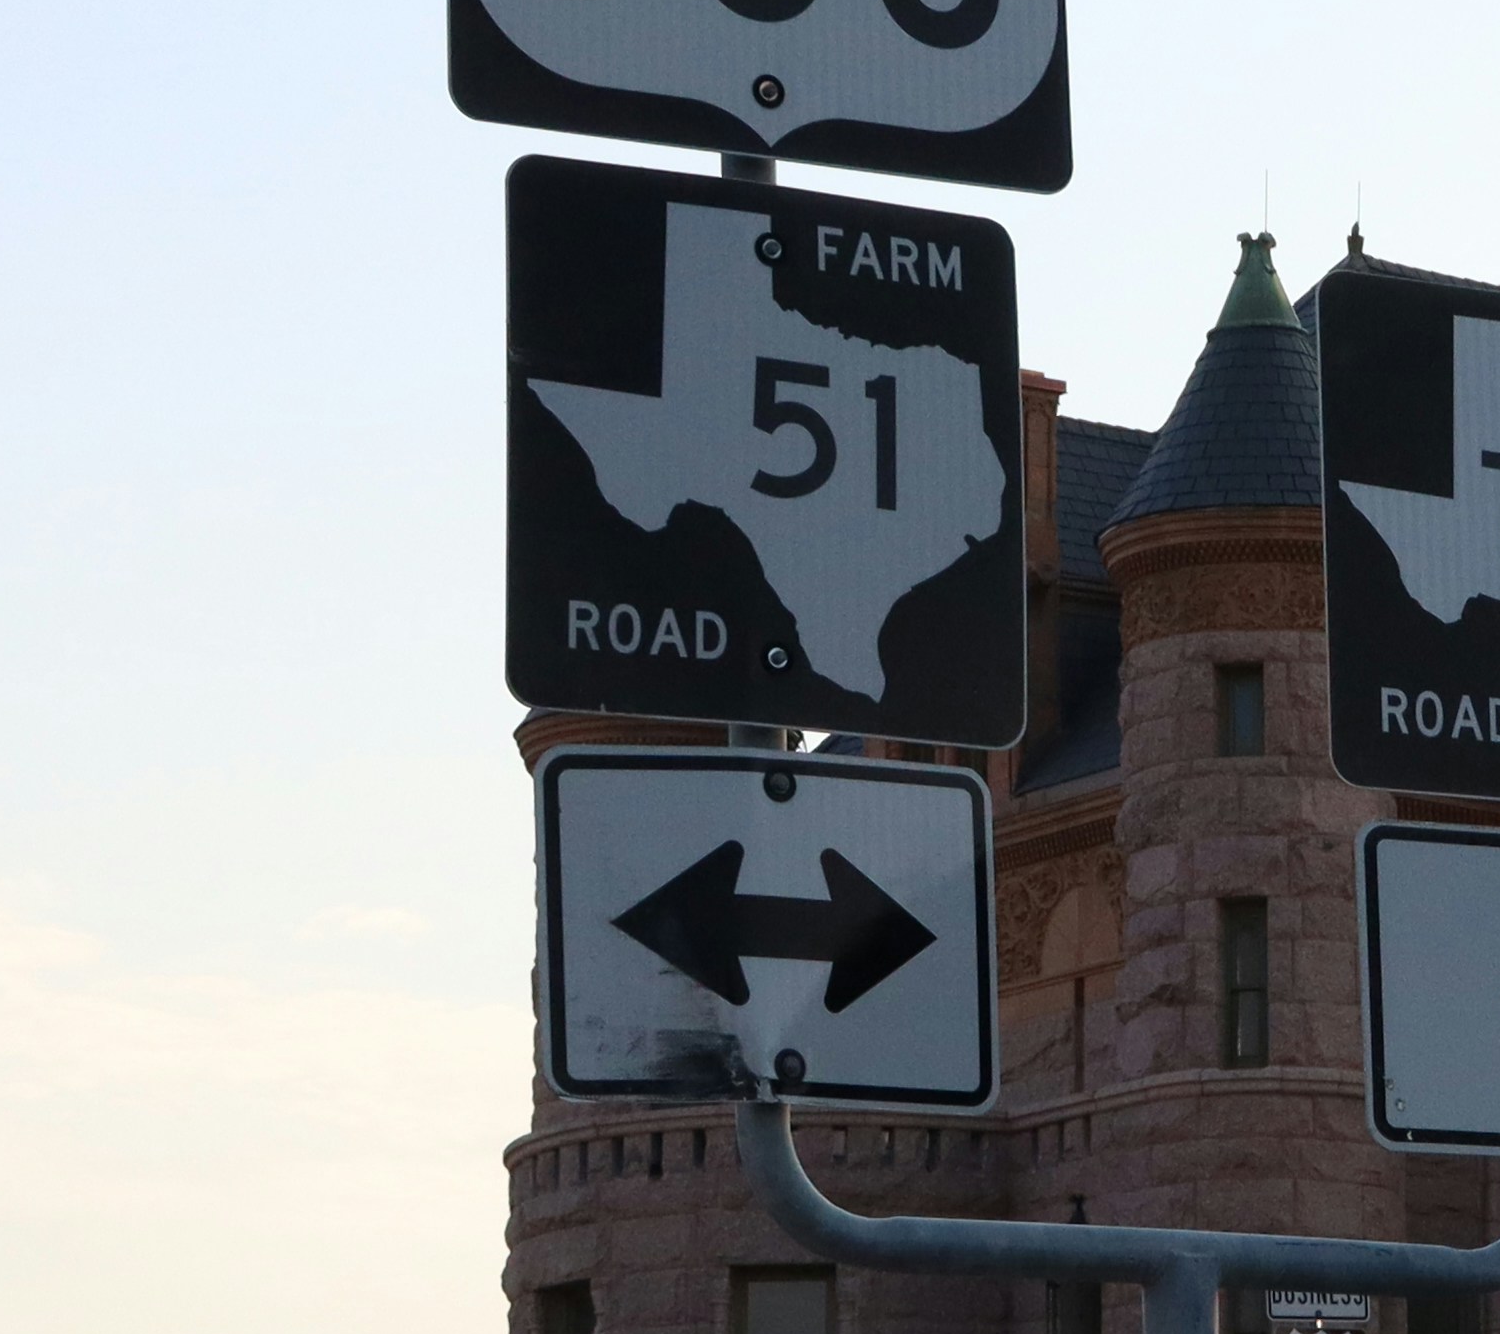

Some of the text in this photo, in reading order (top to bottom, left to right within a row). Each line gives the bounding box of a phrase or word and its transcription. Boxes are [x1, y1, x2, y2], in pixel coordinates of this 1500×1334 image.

[815, 225, 965, 292] FARM
[750, 354, 899, 512] 51
[566, 601, 729, 662] ROAD
